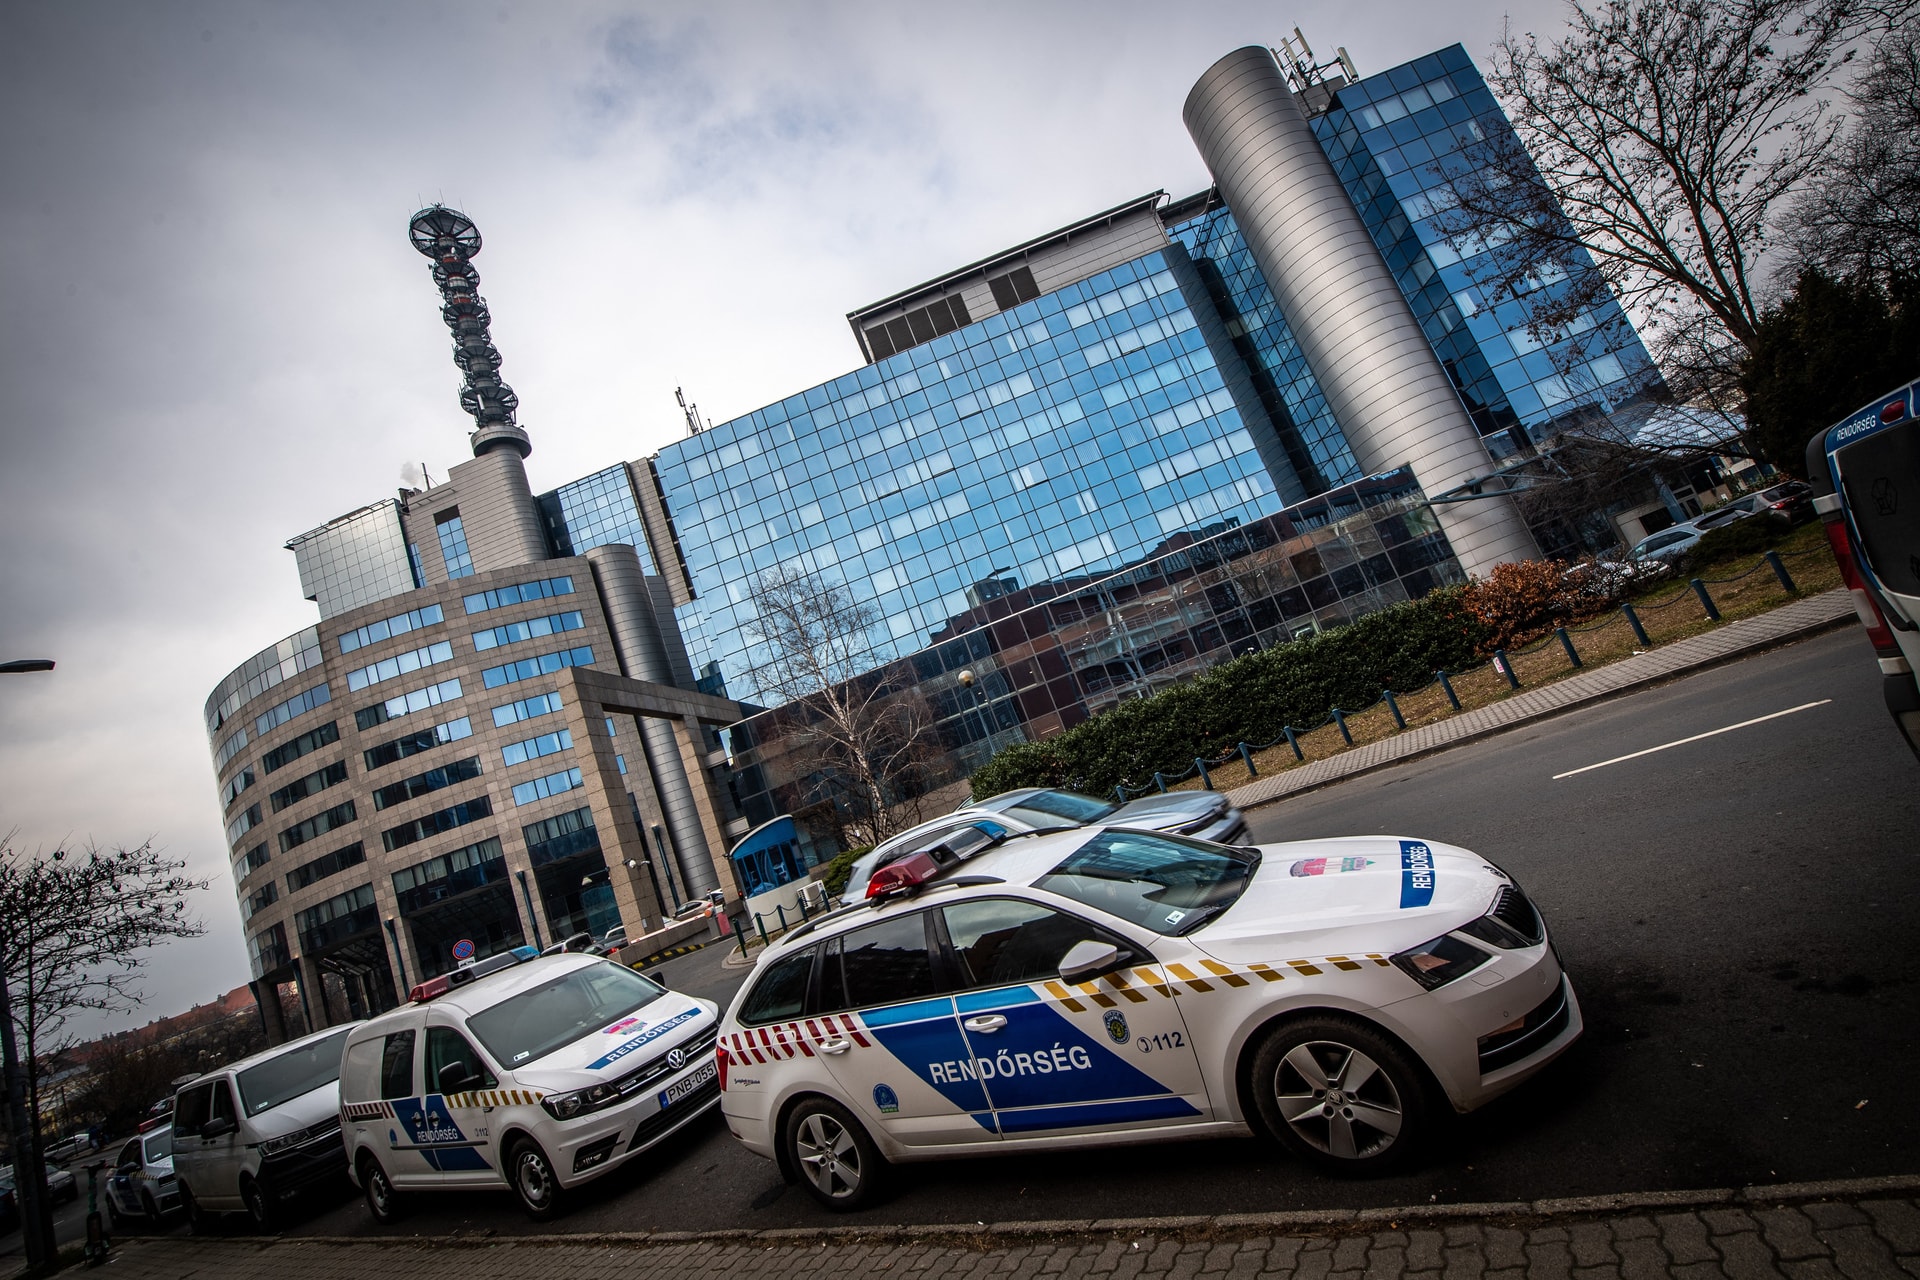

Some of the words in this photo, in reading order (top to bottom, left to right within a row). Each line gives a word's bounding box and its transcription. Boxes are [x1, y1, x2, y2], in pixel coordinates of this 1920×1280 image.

[1405, 846, 1431, 889] RENDŐRSÉG
[1153, 1031, 1185, 1051] 112
[668, 1064, 714, 1101] PNB-055
[928, 1042, 1093, 1085] RENDŐRSÉG
